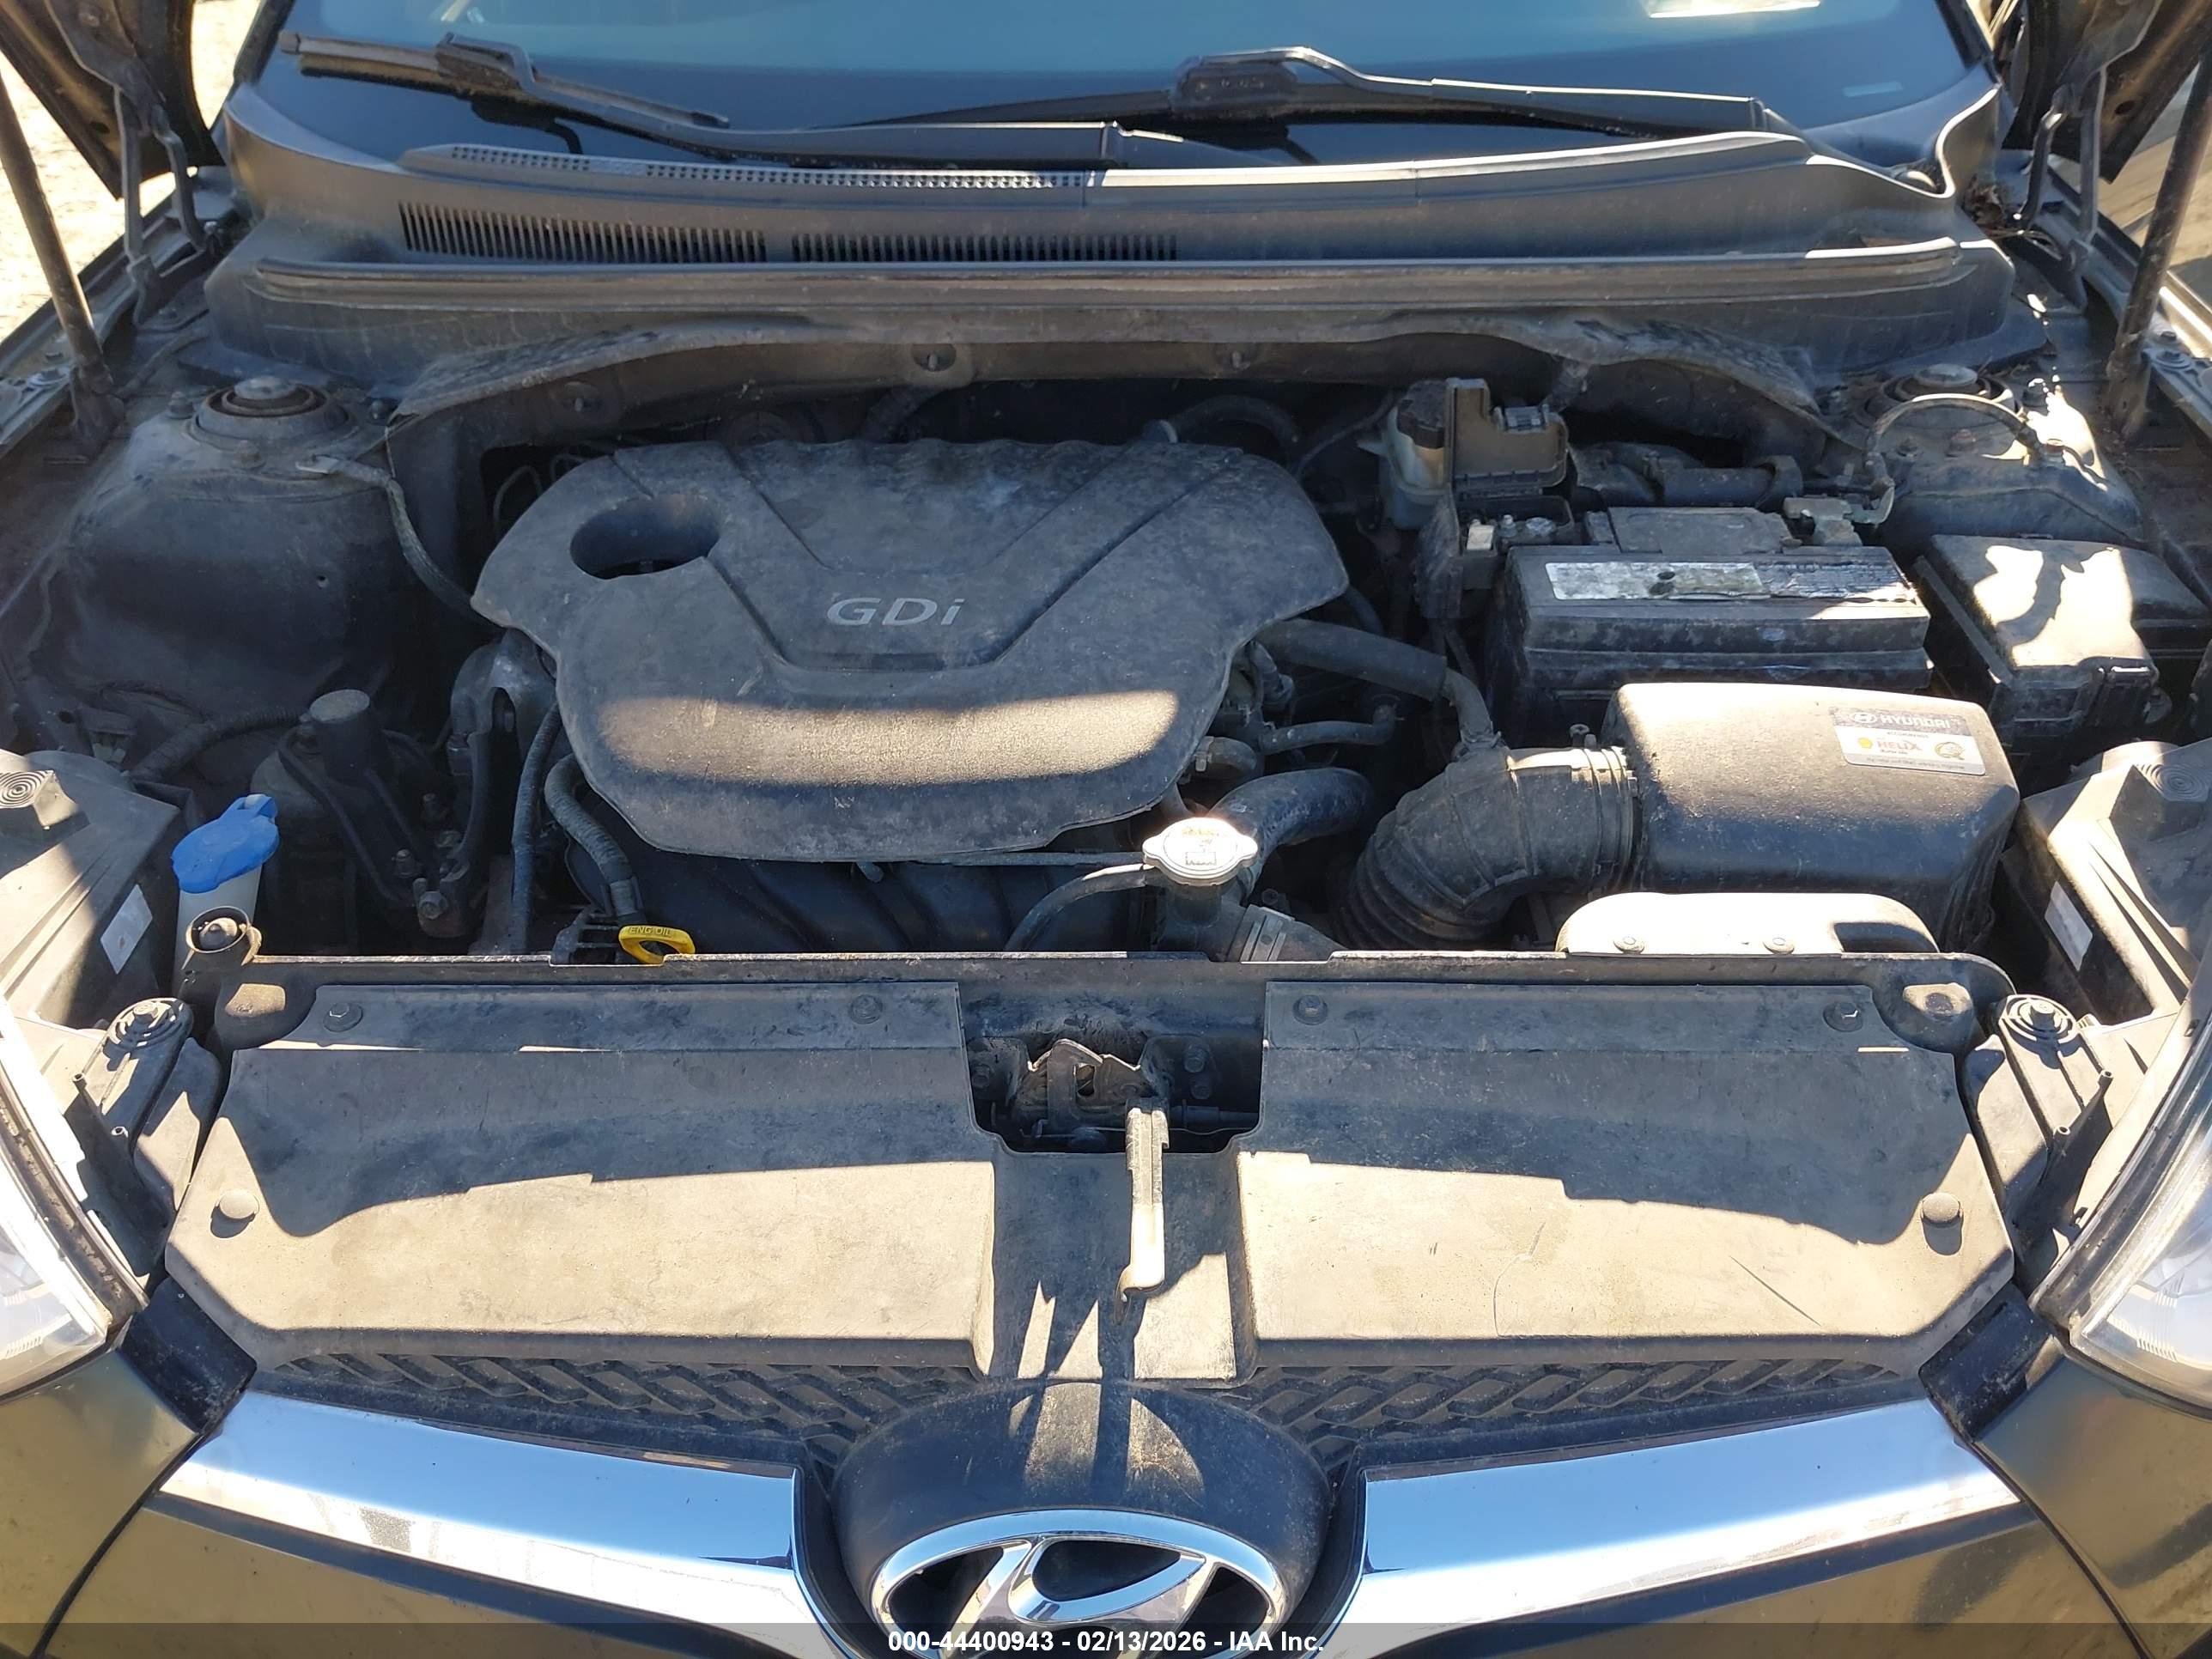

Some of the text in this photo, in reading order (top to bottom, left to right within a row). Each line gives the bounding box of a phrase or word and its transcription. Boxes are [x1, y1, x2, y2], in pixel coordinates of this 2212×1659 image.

[827, 597, 964, 626] GDi
[1880, 714, 1951, 728] HYUNDAI
[1876, 739, 1923, 751] HELIX
[629, 926, 671, 936] ENG OIL
